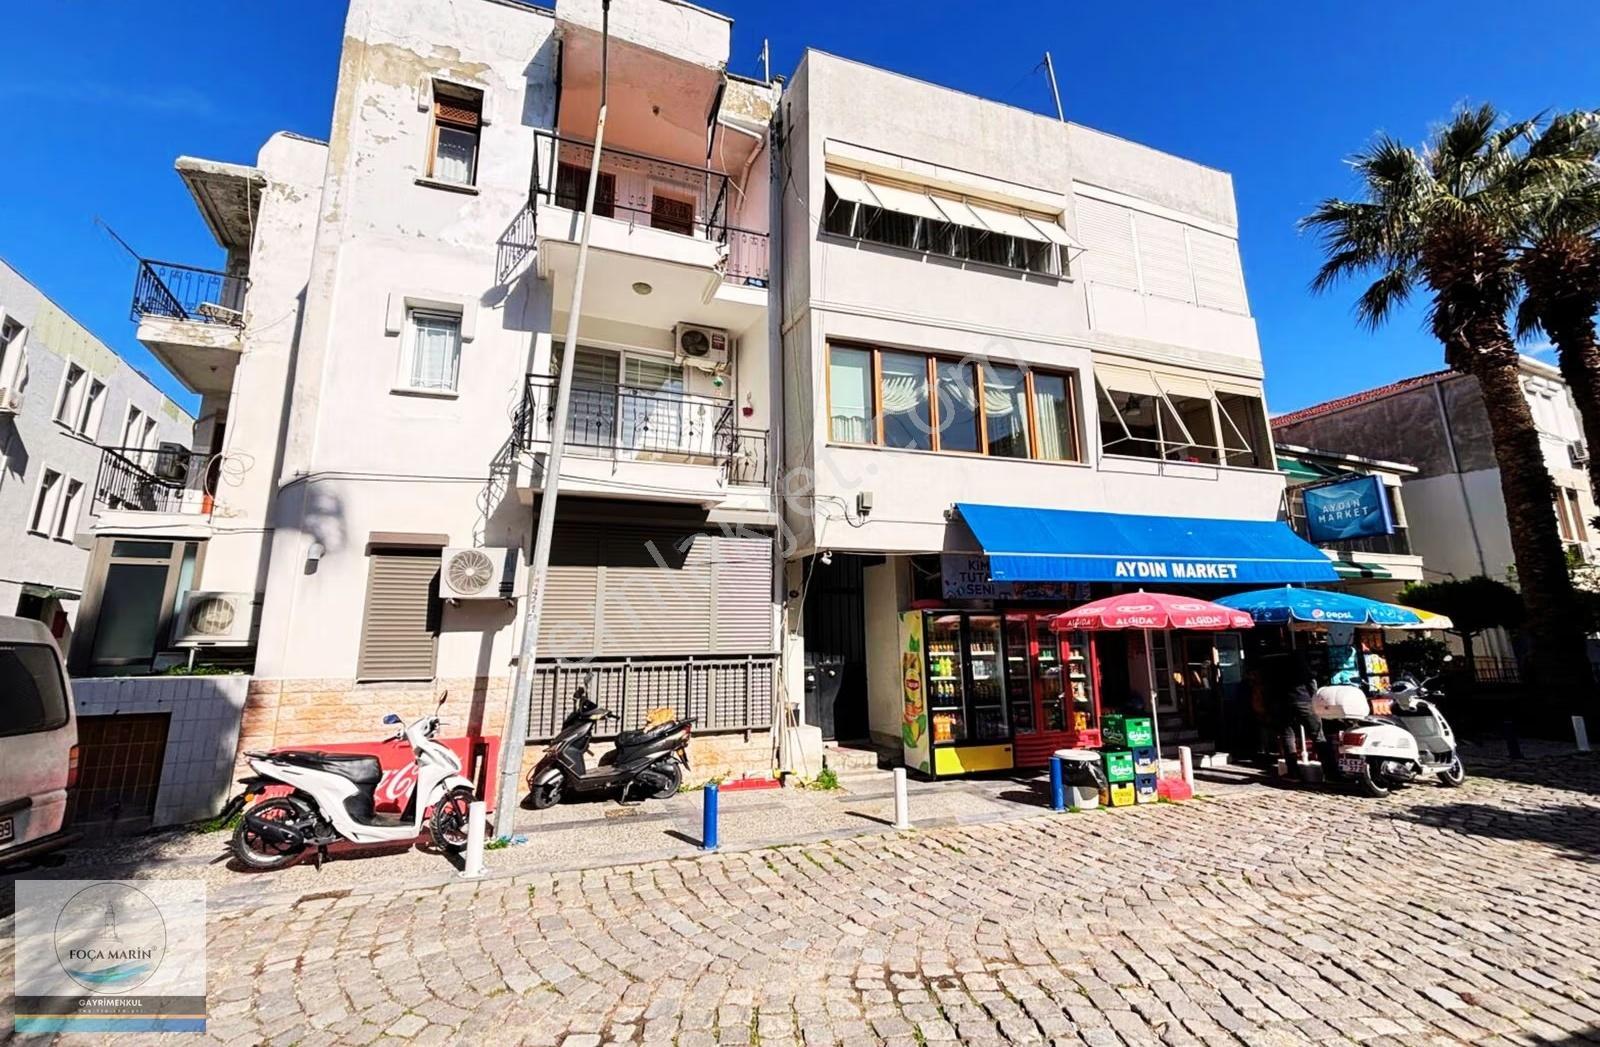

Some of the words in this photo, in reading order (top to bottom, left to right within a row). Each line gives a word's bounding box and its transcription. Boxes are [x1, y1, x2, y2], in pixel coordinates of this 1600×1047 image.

[1318, 506, 1369, 524] MARKET
[1115, 561, 1168, 578] AYDIN
[1171, 563, 1238, 579] MARKET
[1115, 616, 1154, 626] ALGIDA
[1185, 615, 1220, 626] ALGIDA
